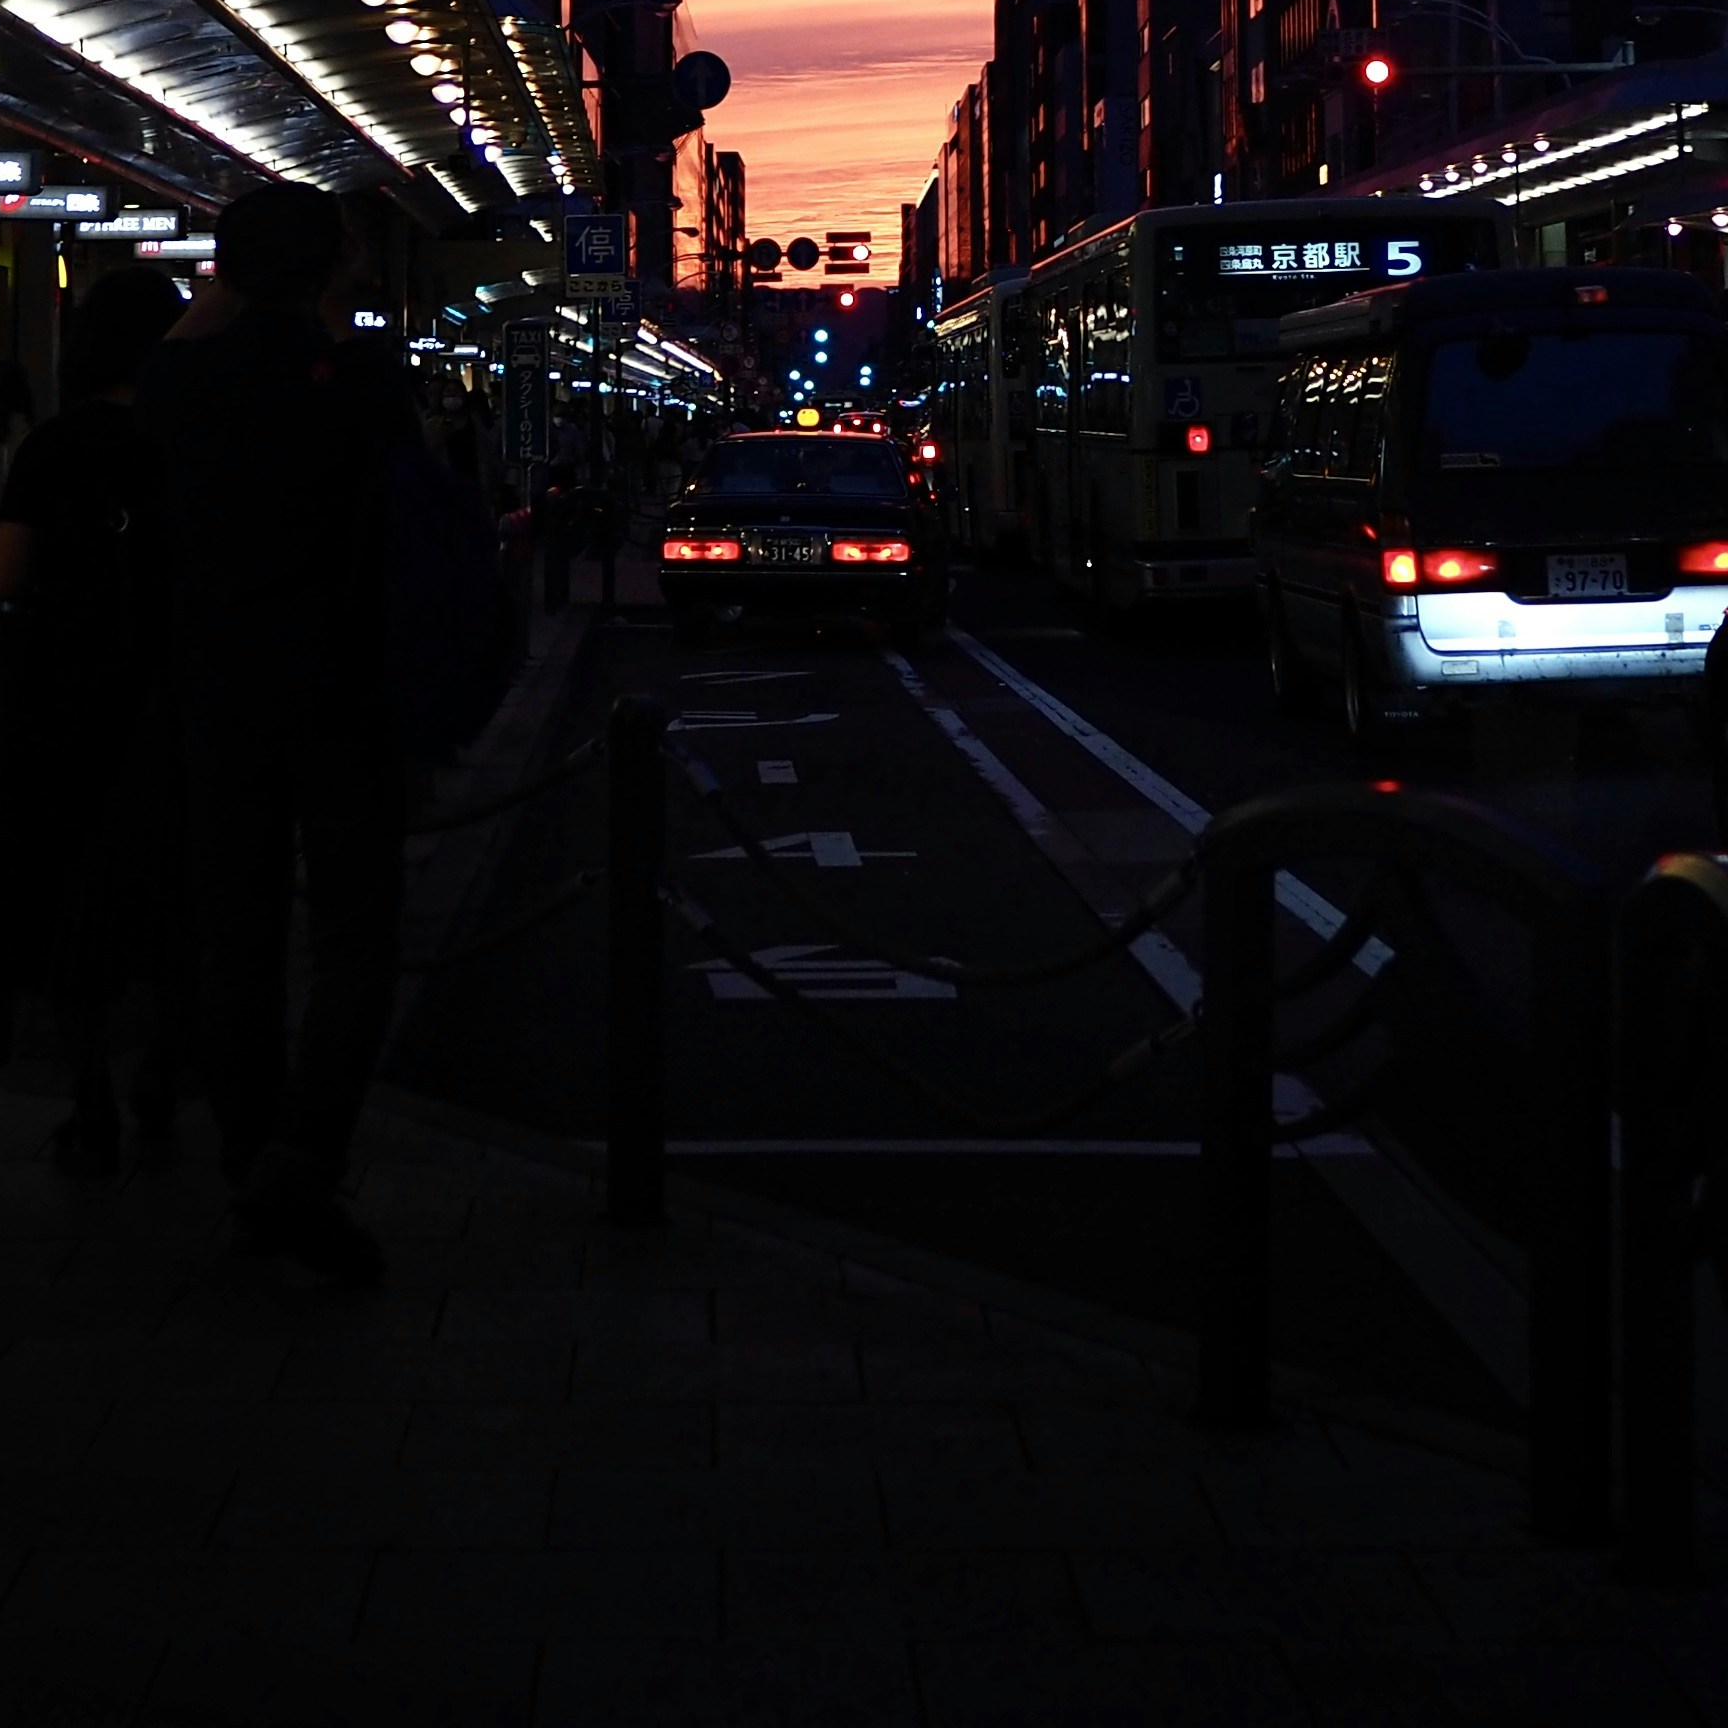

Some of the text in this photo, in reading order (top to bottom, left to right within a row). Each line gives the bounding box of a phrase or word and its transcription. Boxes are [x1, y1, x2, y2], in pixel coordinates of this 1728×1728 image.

[142, 217, 176, 232] MEN
[574, 224, 616, 265] 停
[1270, 242, 1362, 270] 京都駅
[1387, 240, 1423, 276] 5
[568, 279, 623, 294] ここから
[511, 330, 542, 343] TAXI
[771, 546, 810, 561] 31-45
[1565, 569, 1624, 592] 97-70
